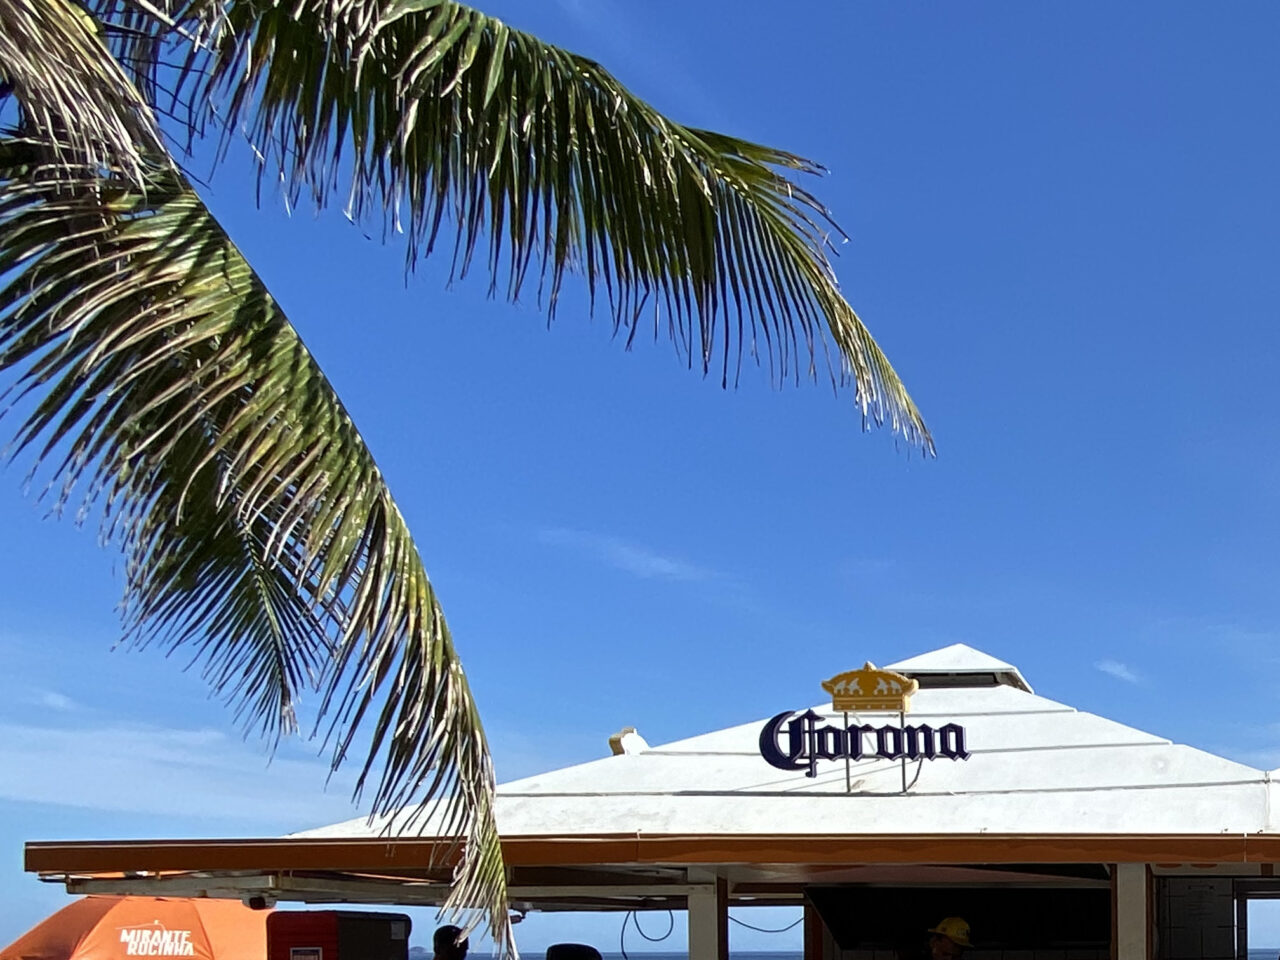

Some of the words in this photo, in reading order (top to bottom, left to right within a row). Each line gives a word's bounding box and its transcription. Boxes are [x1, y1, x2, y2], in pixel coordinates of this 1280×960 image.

[759, 708, 972, 778] Corona
[120, 929, 191, 943] MIRANTE
[126, 940, 194, 956] ROCINHA
